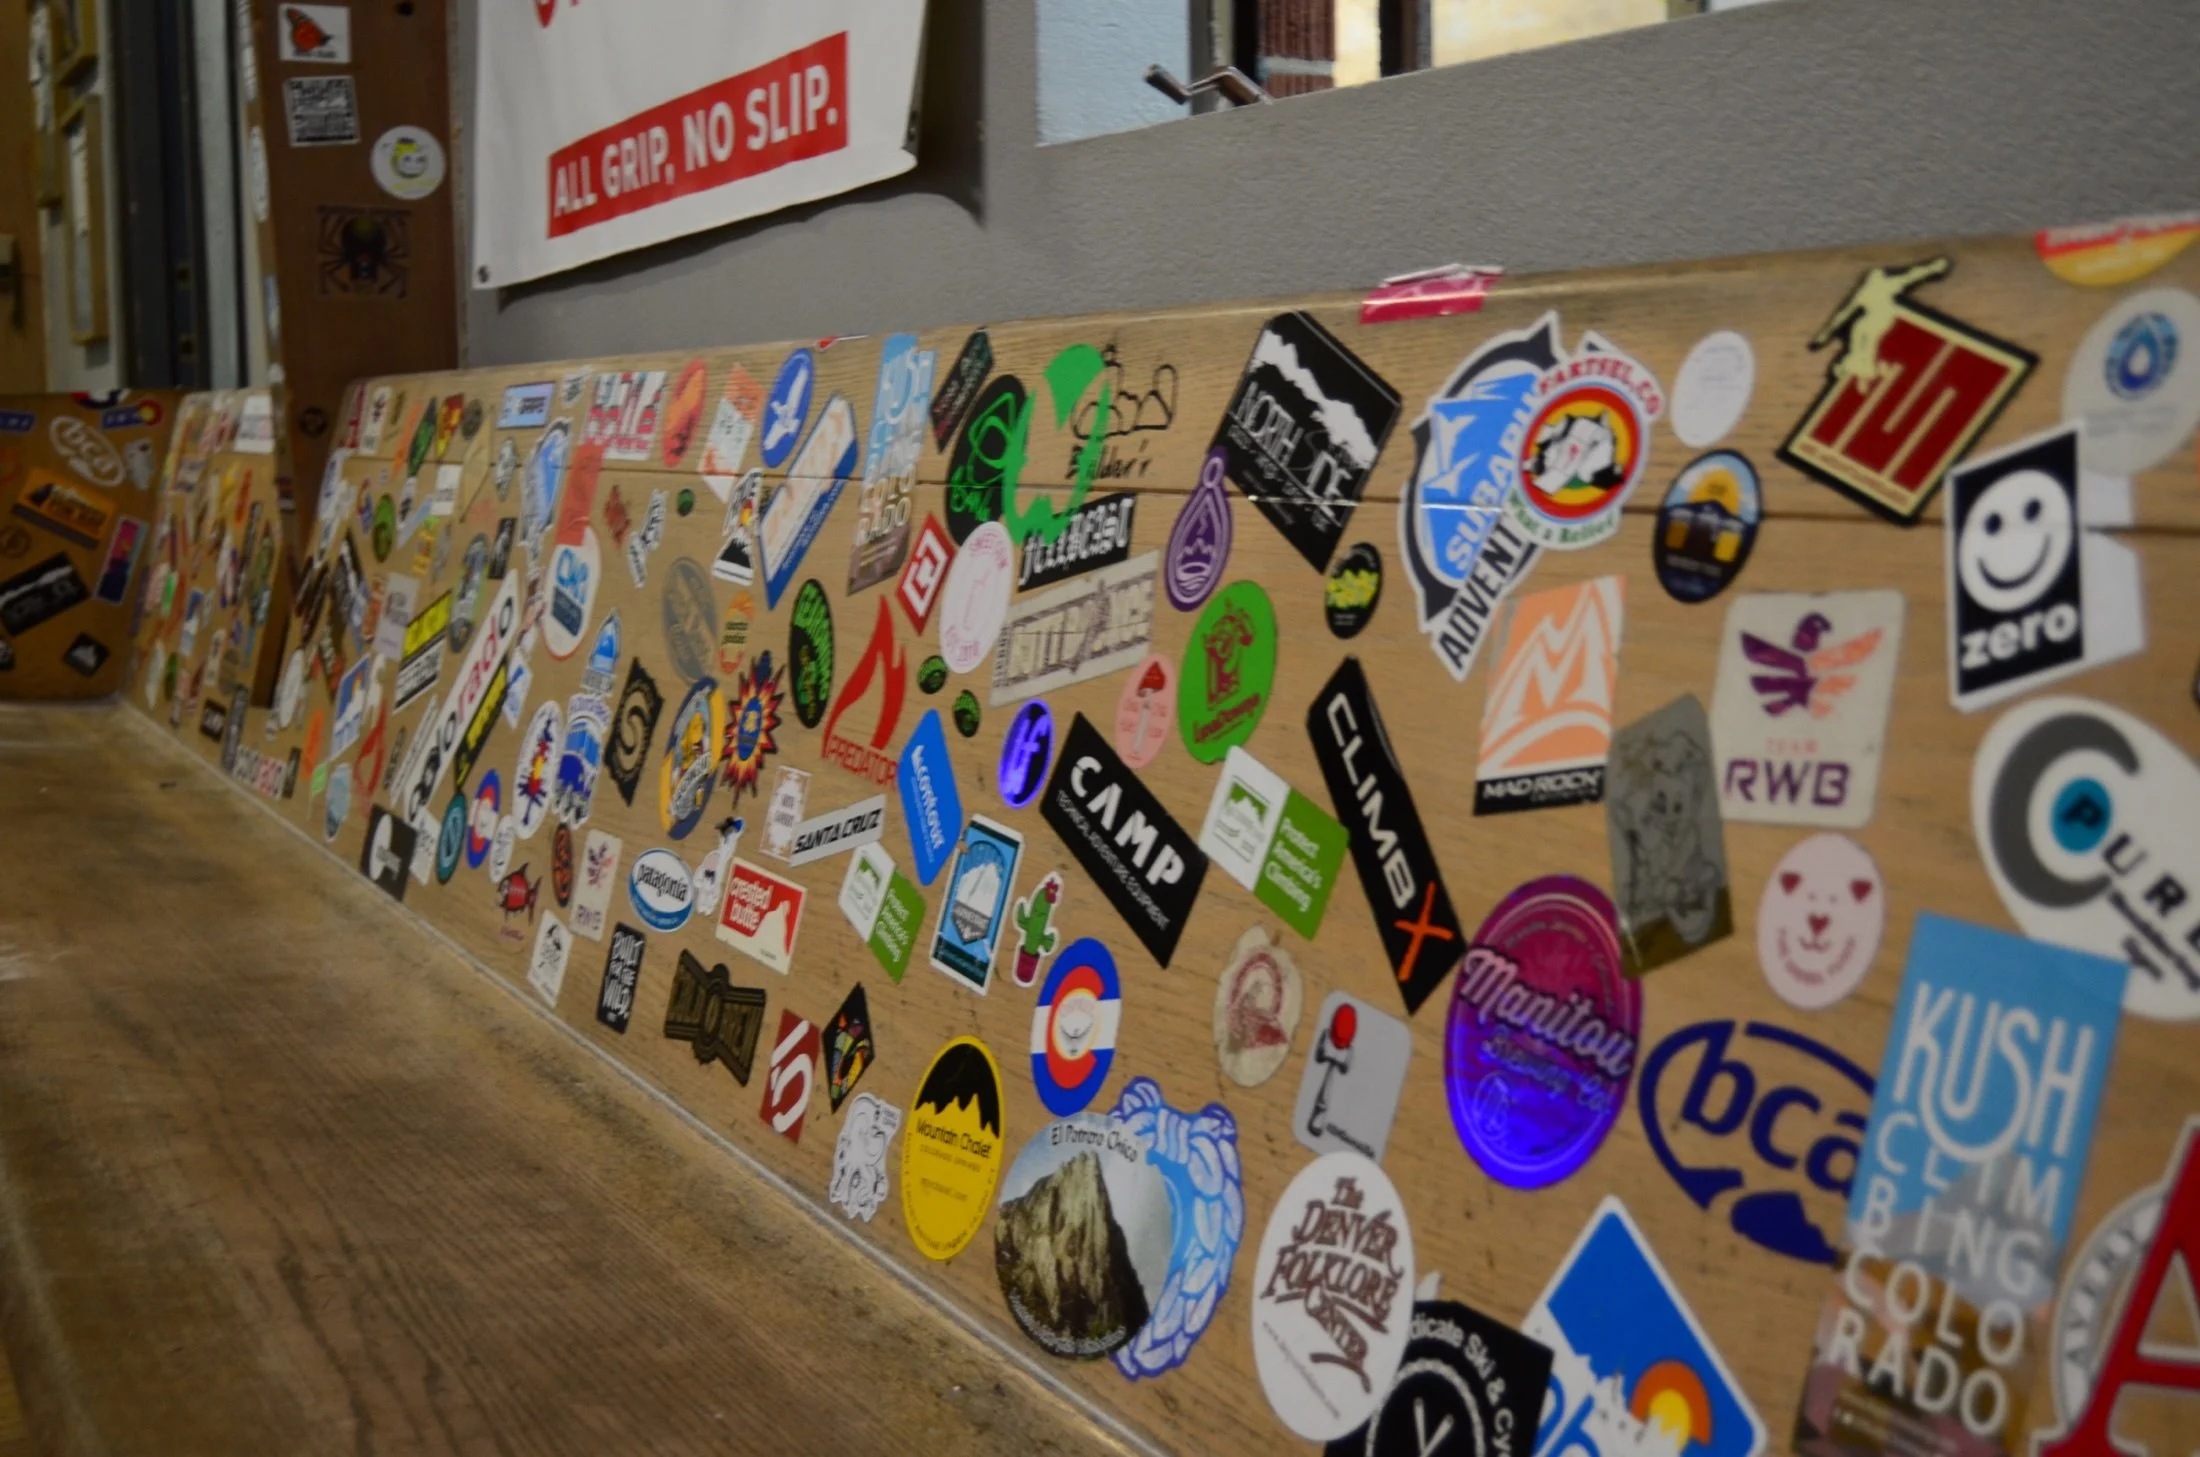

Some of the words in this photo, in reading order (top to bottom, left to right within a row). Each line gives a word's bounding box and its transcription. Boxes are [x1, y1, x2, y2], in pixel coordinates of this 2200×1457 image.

[554, 154, 597, 217] ALL
[601, 126, 675, 198] GRIP,
[683, 102, 735, 172] NO
[747, 64, 838, 151] SLIP.
[1961, 602, 2079, 670] zero
[1070, 755, 1185, 886] CAMP
[1326, 692, 1418, 908] CLIMB
[1724, 758, 1853, 807] RWB
[793, 822, 839, 855] SANTA
[841, 808, 883, 839] CRUZ
[636, 863, 689, 903] patagonia
[1461, 947, 1637, 1080] Manitou
[1893, 981, 2094, 1163] KUSH
[917, 1117, 958, 1146] Mountain
[961, 1132, 992, 1160] Chalet
[1292, 1201, 1404, 1279] DENVER
[1260, 1246, 1404, 1333] FOLKLORE
[1464, 1331, 1498, 1381] Ski
